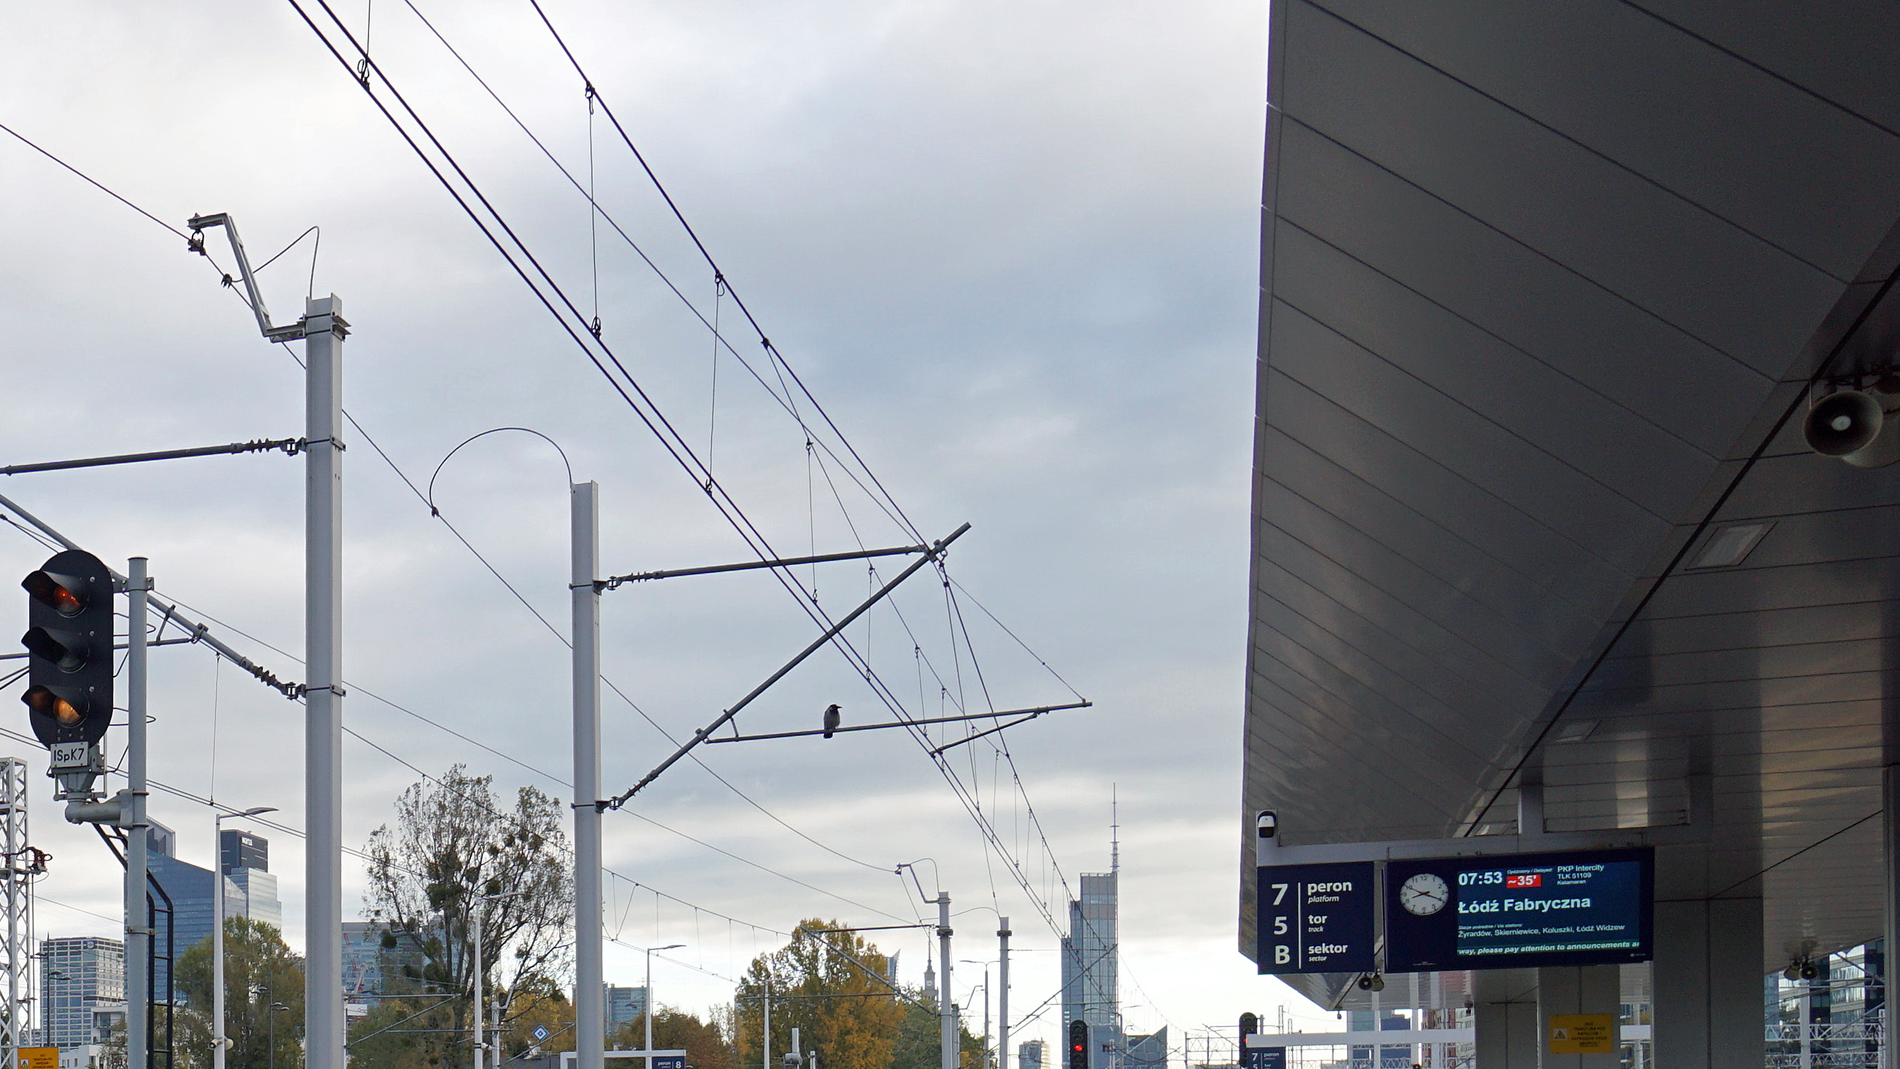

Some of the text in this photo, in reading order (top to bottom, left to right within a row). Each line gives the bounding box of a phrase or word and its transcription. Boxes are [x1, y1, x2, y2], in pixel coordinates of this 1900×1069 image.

[1458, 872, 1503, 886] 07:53
[1272, 884, 1288, 905] 7
[1308, 882, 1352, 895] peron
[1308, 895, 1339, 904] platform
[1458, 898, 1591, 913] Łódź Fabryczna
[1274, 916, 1288, 935] 5
[1308, 915, 1327, 924] tor
[1275, 945, 1290, 964] B
[1308, 943, 1348, 954] sektor
[1478, 947, 1503, 955] please
[1521, 944, 1555, 952] attention
[1566, 942, 1630, 950] announcements
[1252, 1053, 1258, 1061] 7
